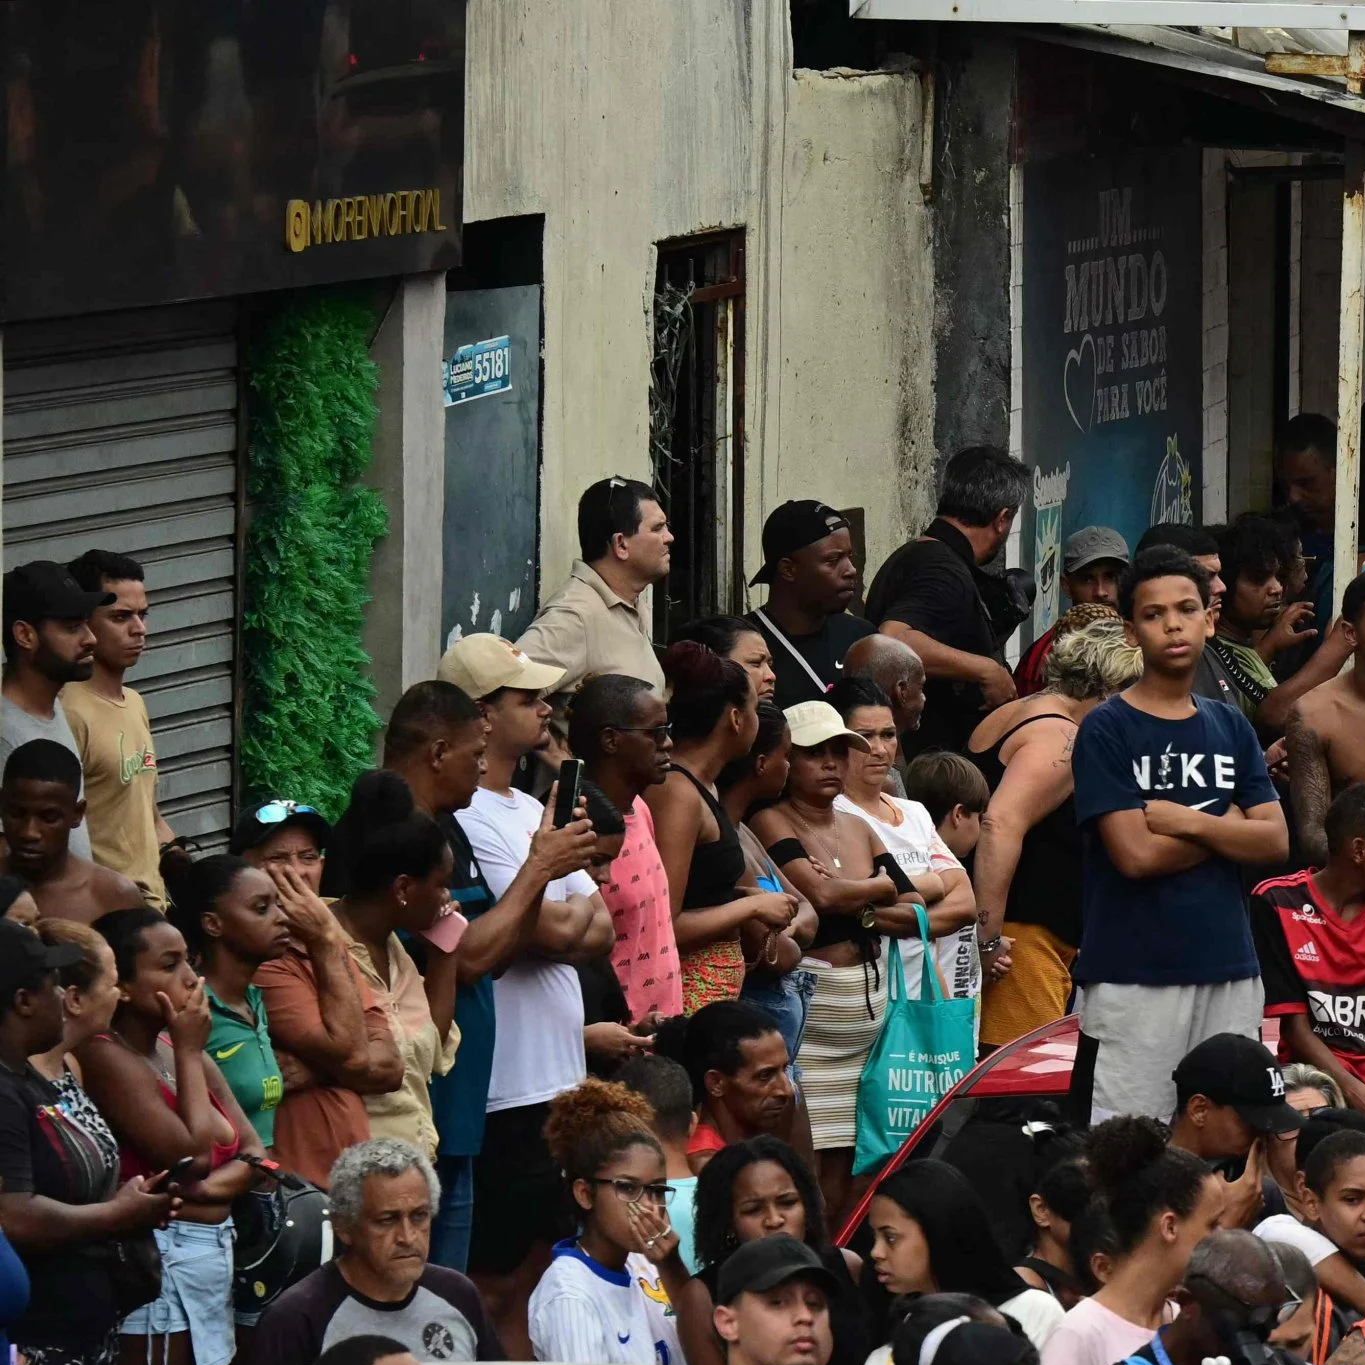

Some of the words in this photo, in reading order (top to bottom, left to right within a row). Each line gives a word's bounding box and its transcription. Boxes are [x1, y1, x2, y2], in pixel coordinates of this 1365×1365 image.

[1064, 250, 1168, 334] MUNDO
[474, 347, 509, 385] 55181
[1097, 335, 1115, 375] DE
[1121, 325, 1168, 371] SABOR
[1097, 382, 1130, 424] PARA
[1134, 367, 1168, 416] VOCÊ
[1132, 742, 1236, 791] NIKE
[1294, 952, 1321, 963] adidas
[1266, 1067, 1285, 1097] LA
